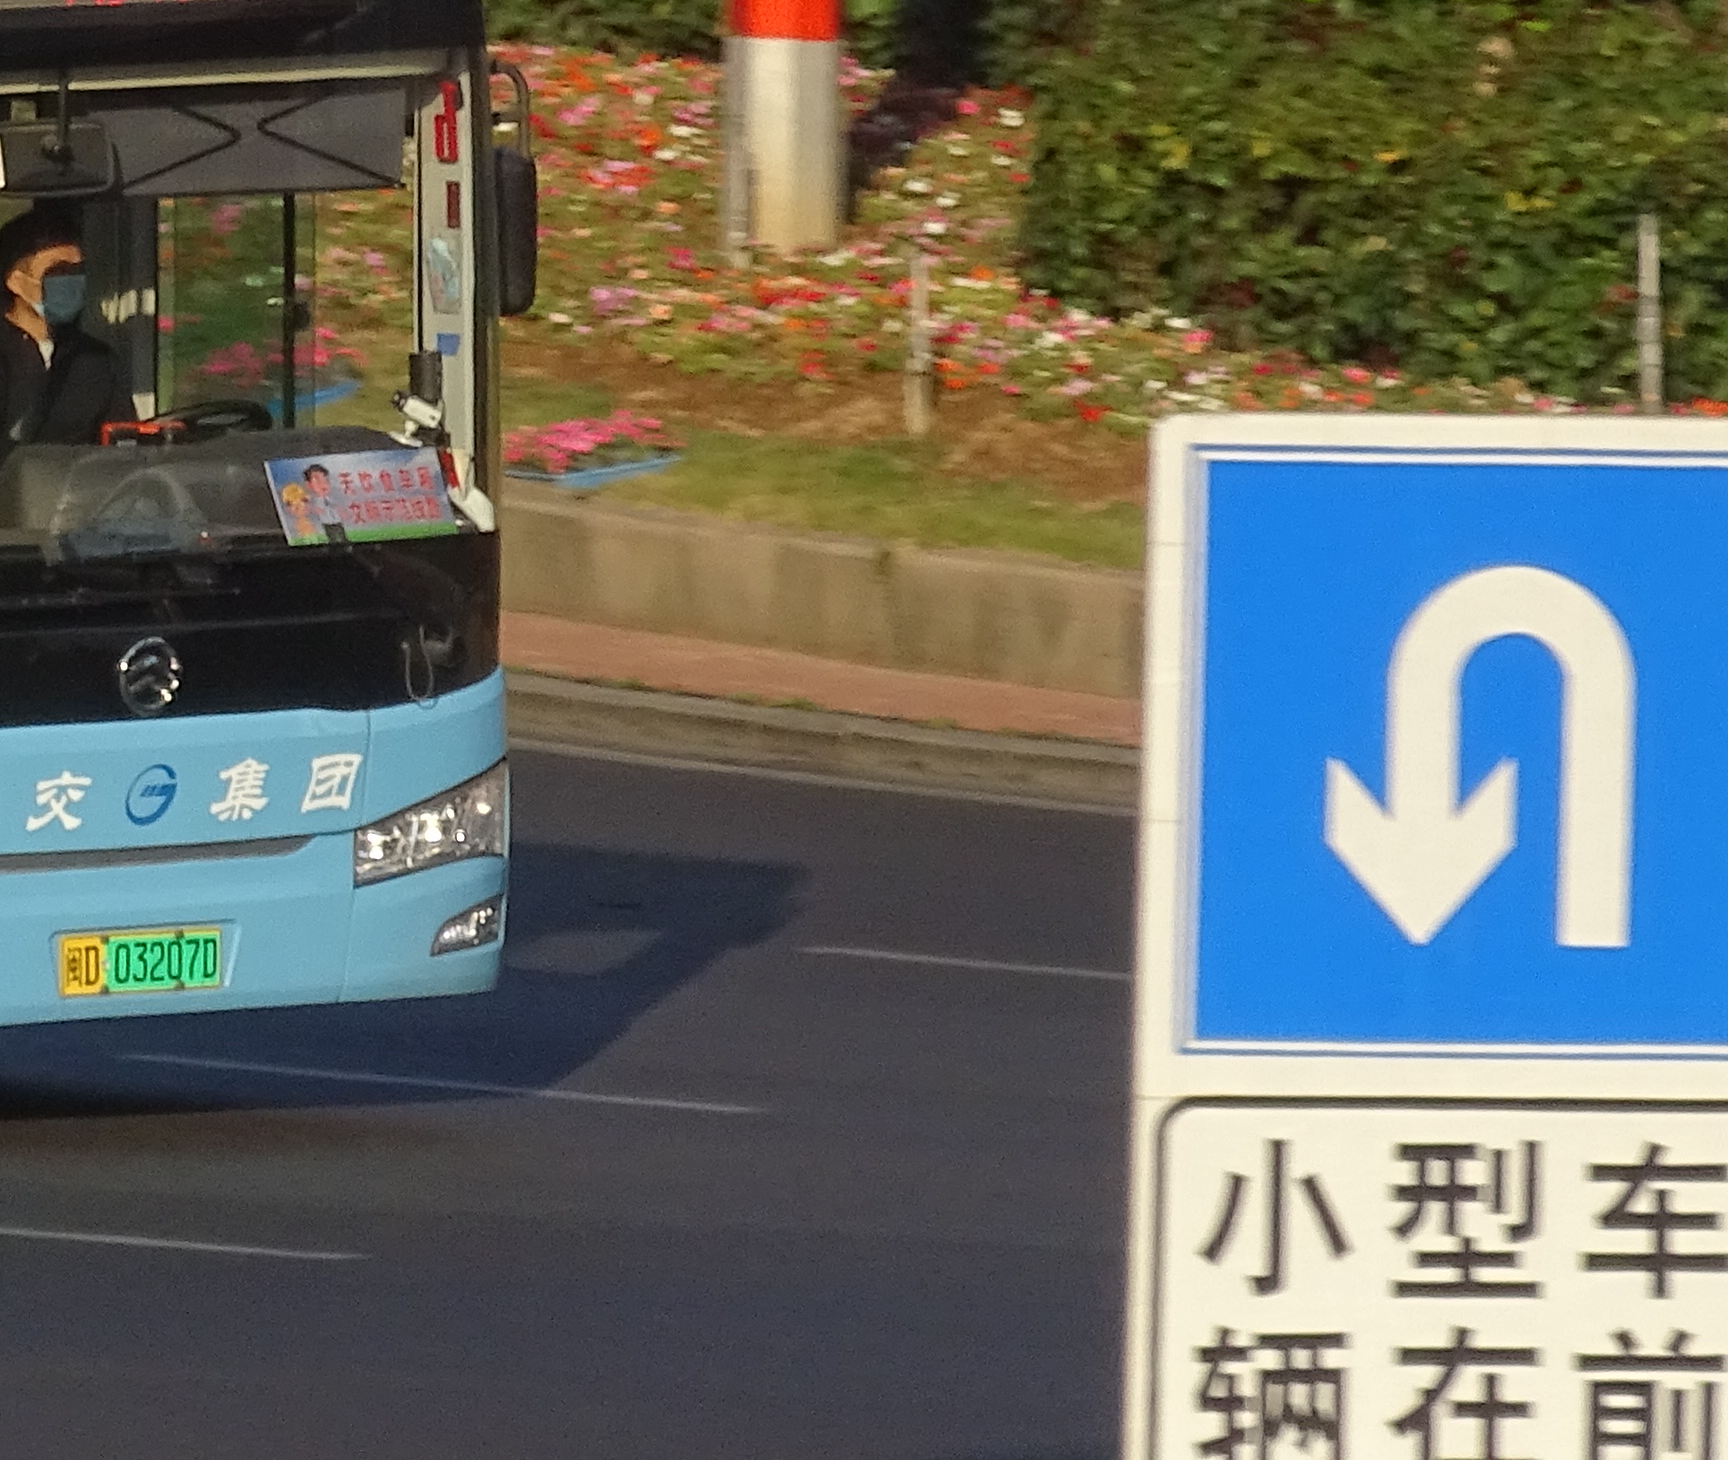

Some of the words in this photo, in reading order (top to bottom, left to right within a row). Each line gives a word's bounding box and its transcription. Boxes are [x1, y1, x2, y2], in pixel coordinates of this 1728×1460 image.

[208, 753, 364, 823] 集团
[1193, 1138, 1728, 1299] 小型车
